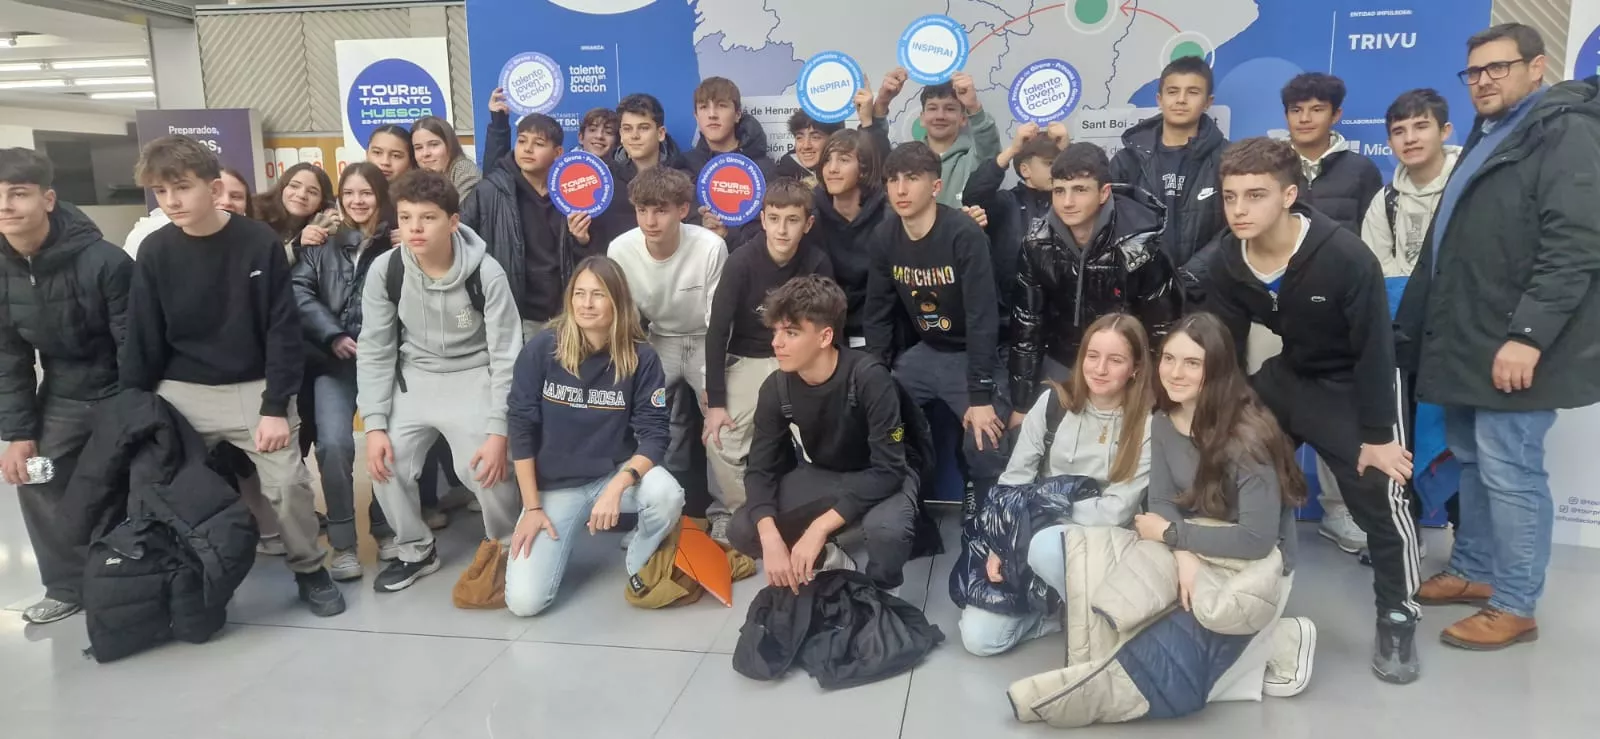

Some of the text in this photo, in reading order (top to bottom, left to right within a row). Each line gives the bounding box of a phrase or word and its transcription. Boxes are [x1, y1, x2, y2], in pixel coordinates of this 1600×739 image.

[1348, 32, 1417, 50] TRIVU
[569, 65, 605, 75] talento
[570, 75, 598, 85] joven
[1023, 76, 1061, 95] talento
[358, 85, 431, 97] TOUR DEL
[1025, 87, 1055, 105] joven
[359, 96, 432, 106] TALENTO
[361, 107, 433, 118] HUESCA
[750, 107, 762, 115] de
[1082, 120, 1106, 129] Sant
[1110, 119, 1127, 129] Boi
[168, 125, 220, 135] Preparados,
[561, 177, 586, 190] TOUR
[562, 179, 599, 194] TALENTO
[712, 180, 739, 190] TOUR
[712, 187, 751, 195] TALENTO
[587, 389, 626, 406] ROSA
